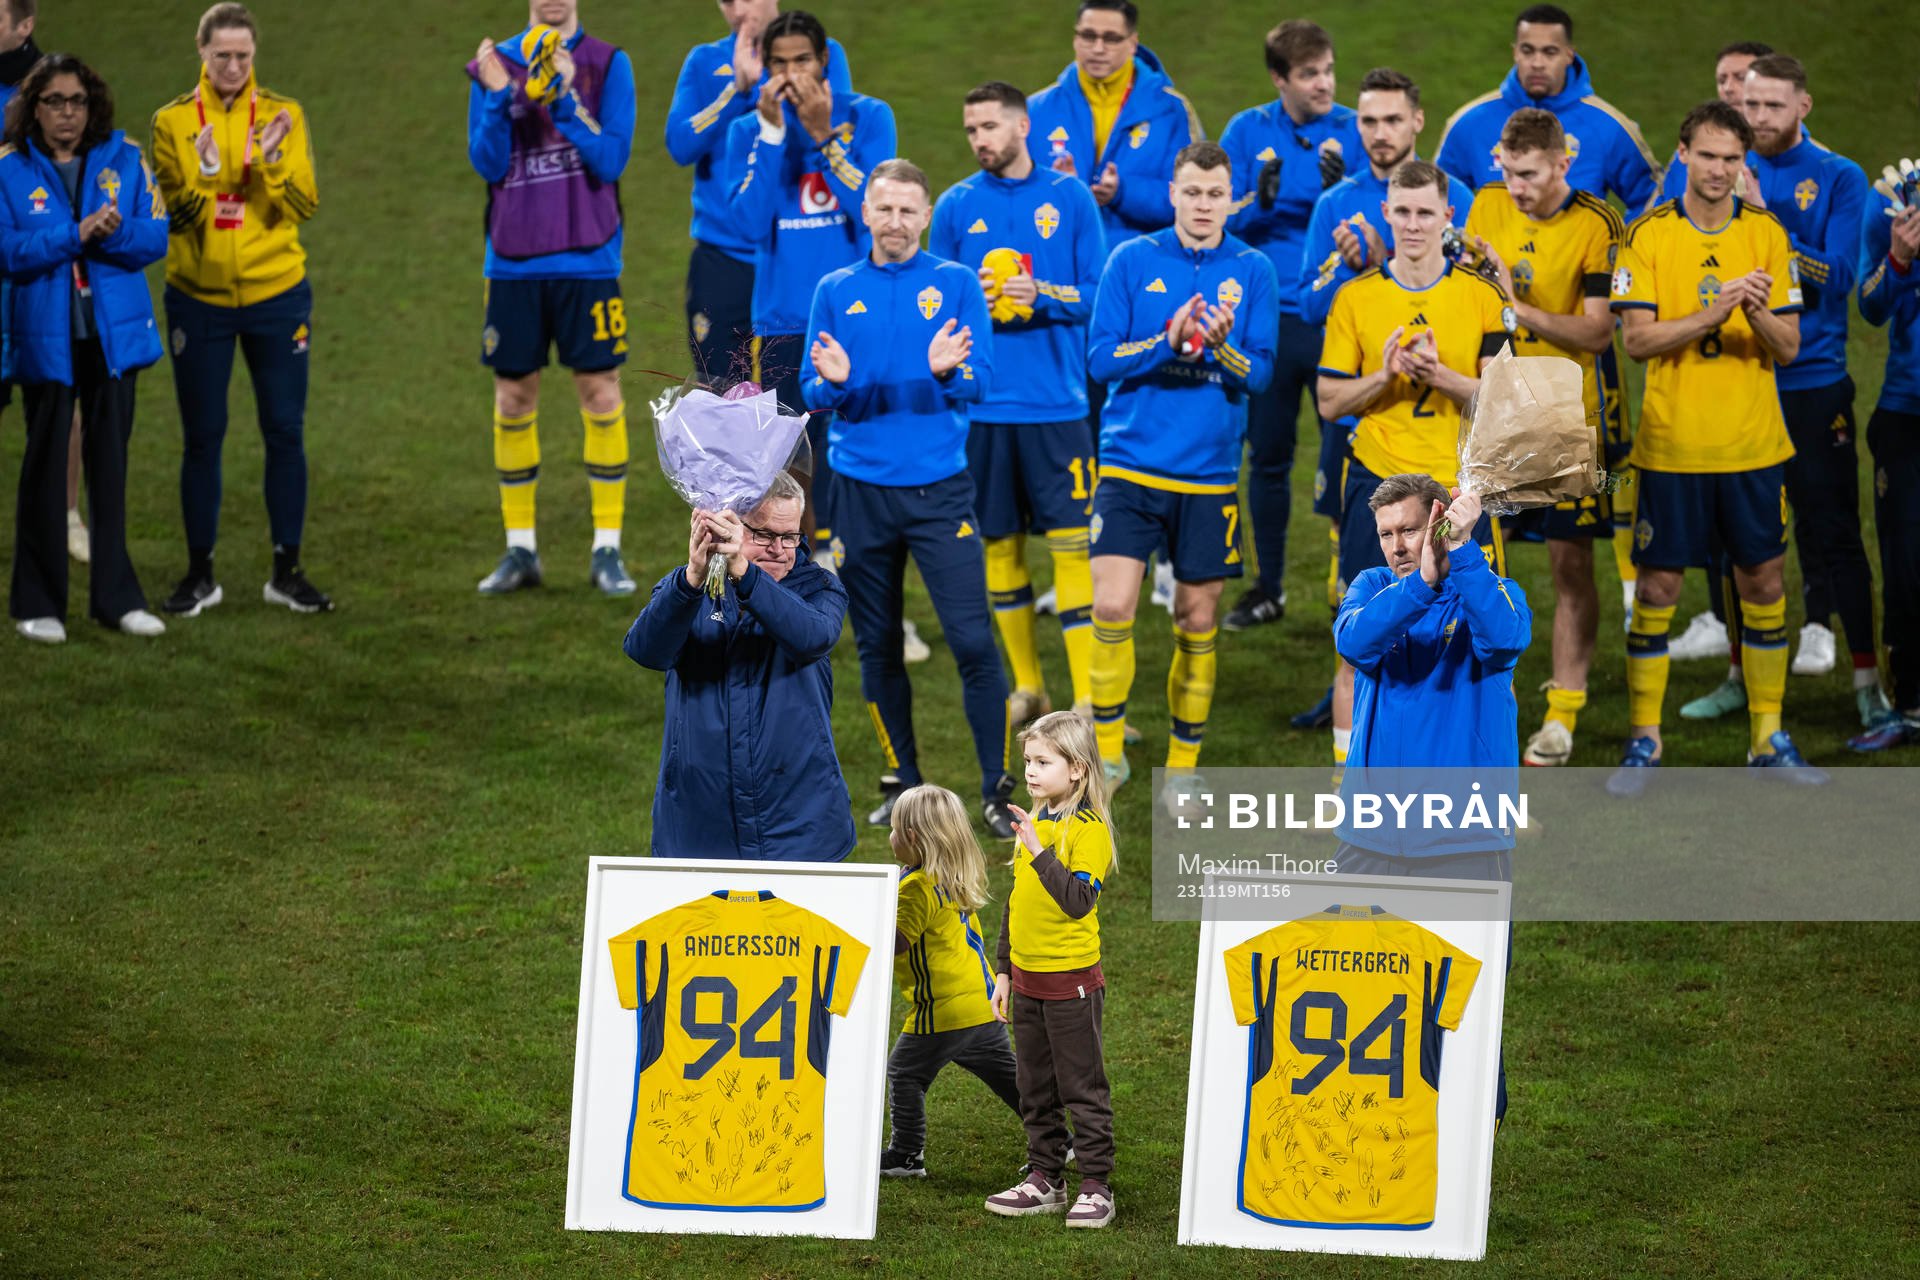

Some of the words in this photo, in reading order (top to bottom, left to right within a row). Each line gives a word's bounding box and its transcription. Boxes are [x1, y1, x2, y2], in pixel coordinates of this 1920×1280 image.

[589, 297, 627, 341] 18
[1221, 503, 1239, 548] 7
[729, 895, 757, 904] SVERIGE
[684, 935, 800, 957] ANDERSSON
[1295, 948, 1410, 975] WETTERGREN
[680, 976, 798, 1080] 94
[1289, 991, 1408, 1098] 94
